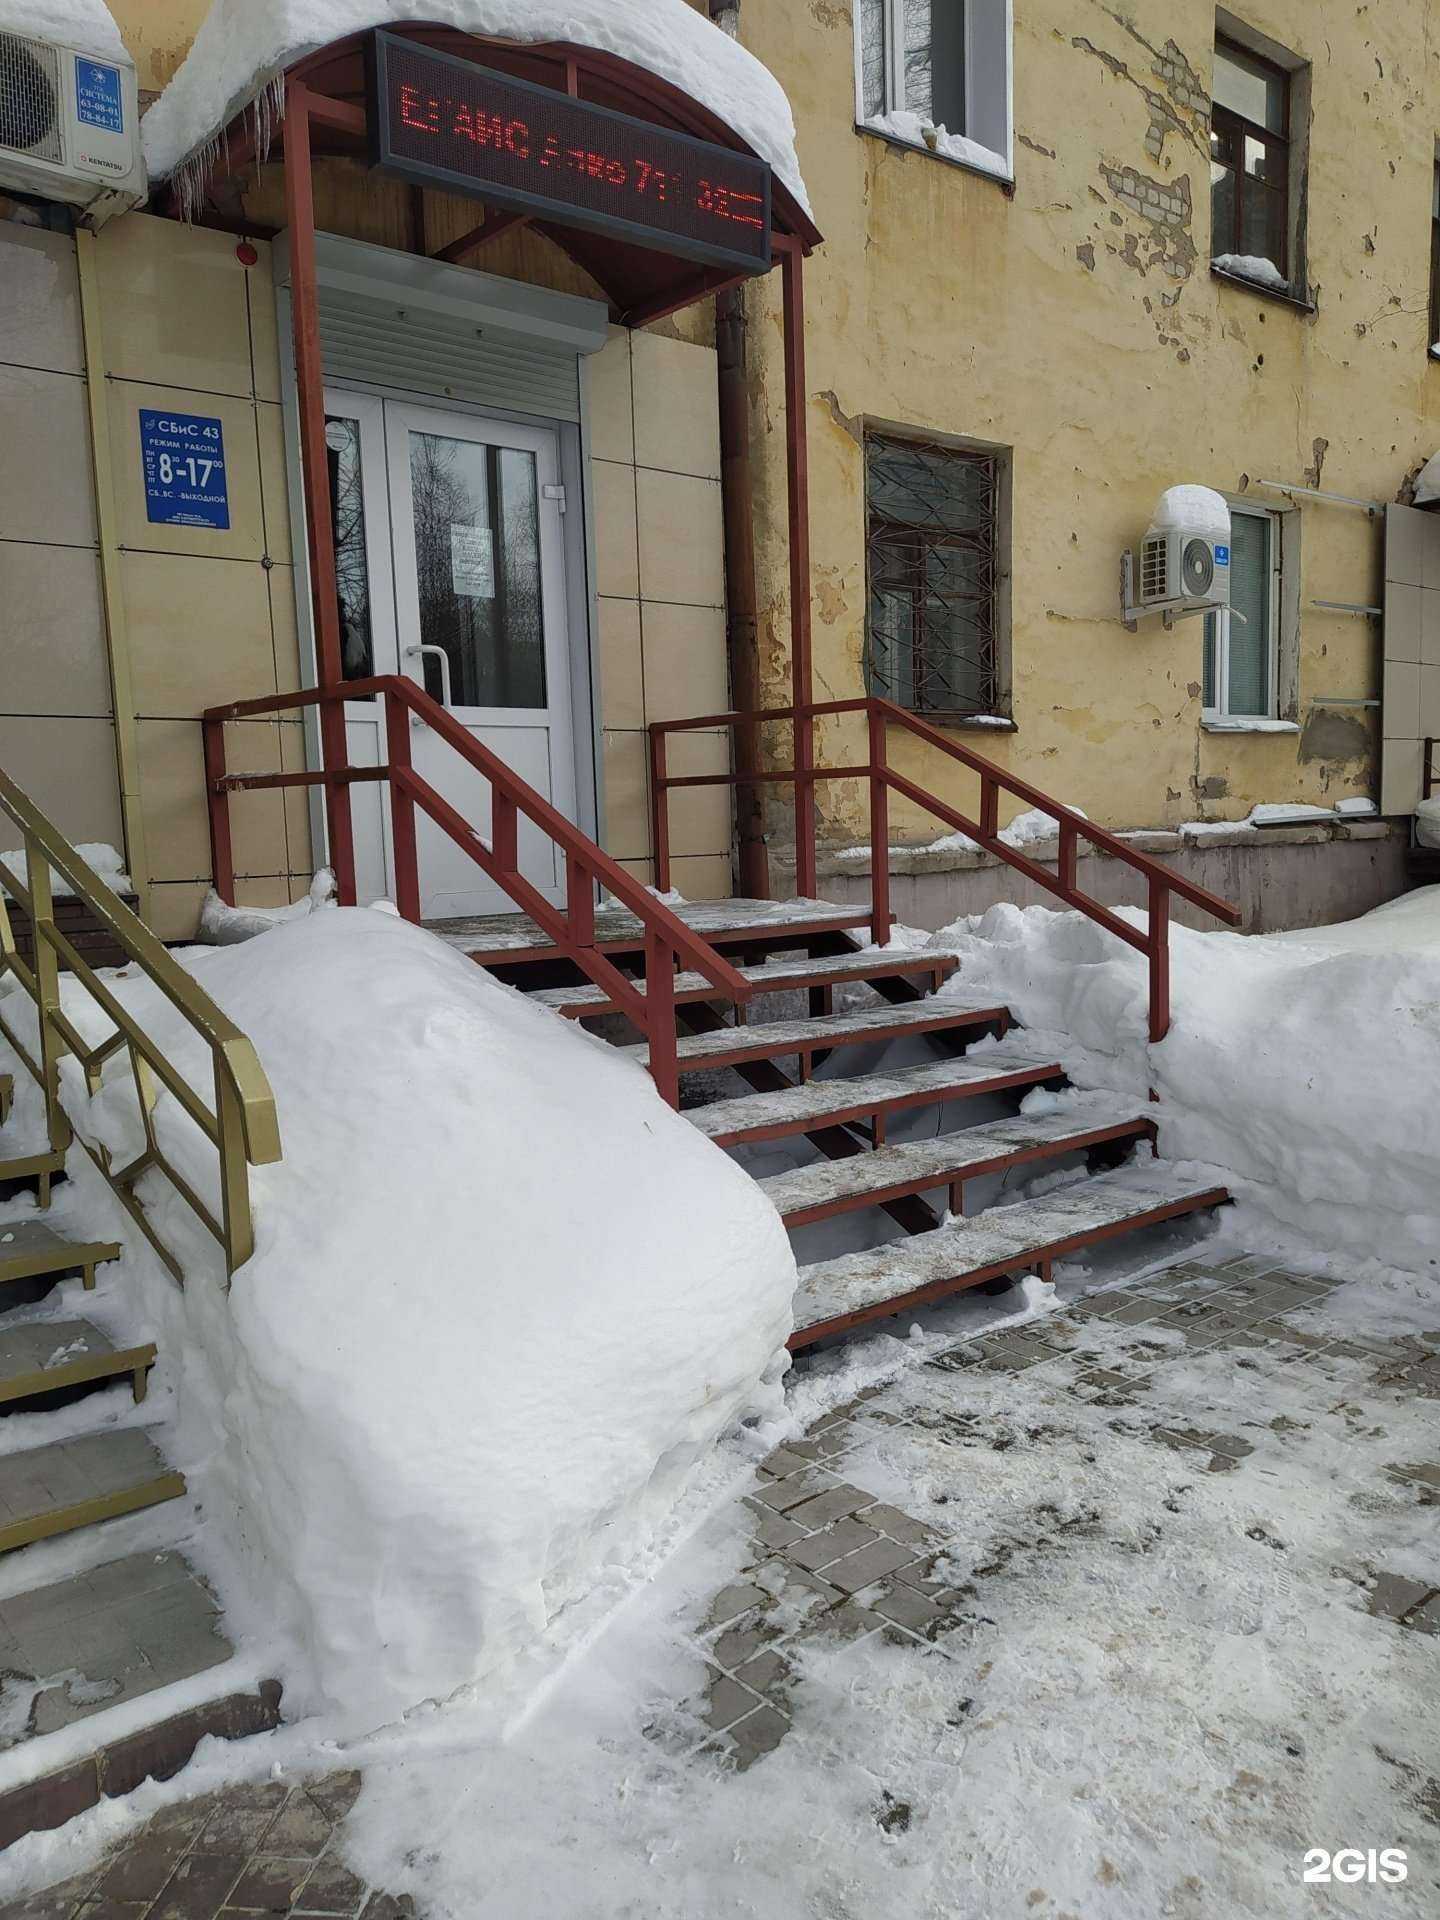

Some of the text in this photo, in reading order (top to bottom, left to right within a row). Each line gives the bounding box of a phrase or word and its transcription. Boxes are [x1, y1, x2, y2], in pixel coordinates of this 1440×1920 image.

[158, 420, 219, 439] СБиС 43
[149, 438, 218, 453] РЕЖИМ РАБОТЫ
